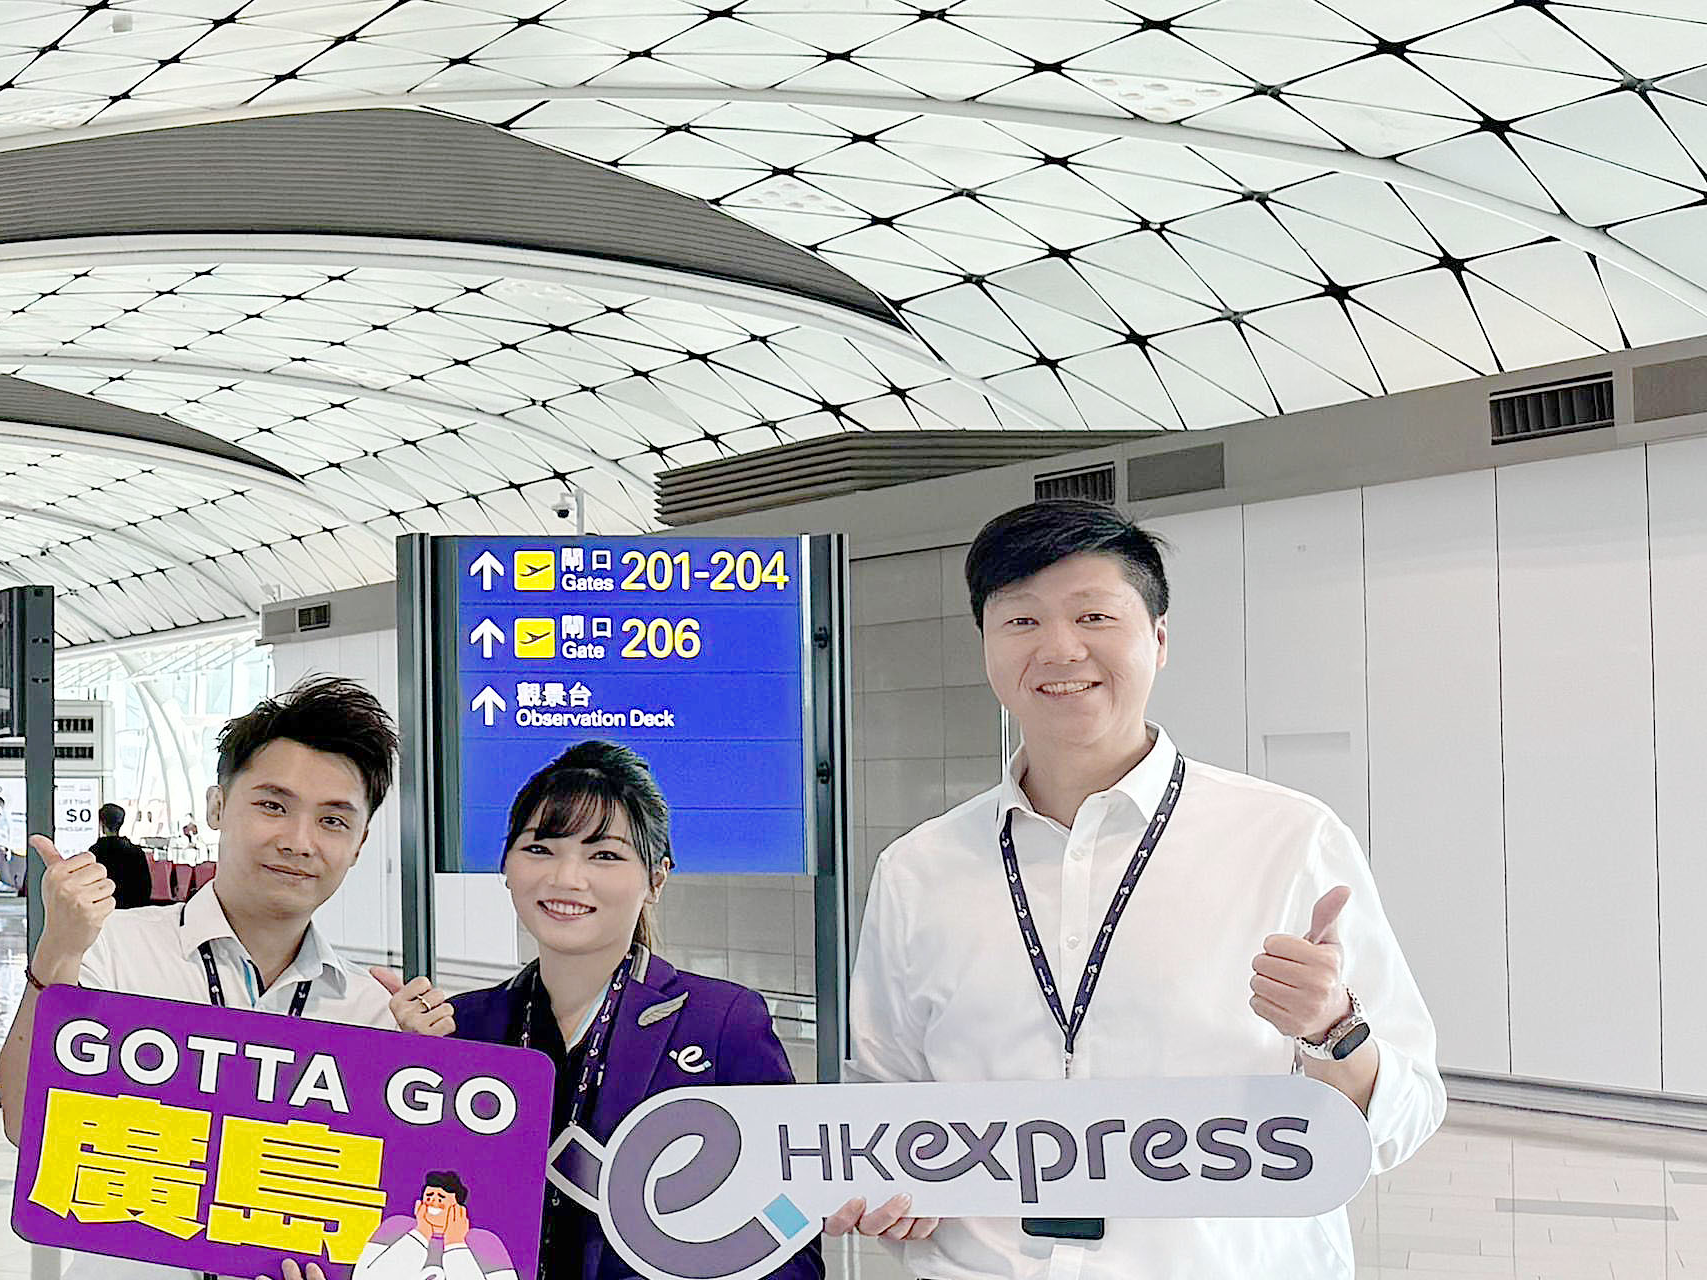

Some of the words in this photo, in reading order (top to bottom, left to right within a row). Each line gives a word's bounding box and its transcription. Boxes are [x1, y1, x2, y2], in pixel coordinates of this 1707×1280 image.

[561, 574, 614, 592] Gates
[620, 549, 790, 591] 201-204
[561, 641, 605, 659] Gate
[620, 617, 702, 659] 206
[515, 708, 626, 727] Observation
[630, 709, 675, 727] Deck
[53, 1019, 350, 1114] GOTTA
[385, 1066, 519, 1135] GO
[27, 1087, 387, 1266] 廣島
[778, 1116, 1314, 1205] HKexpress
